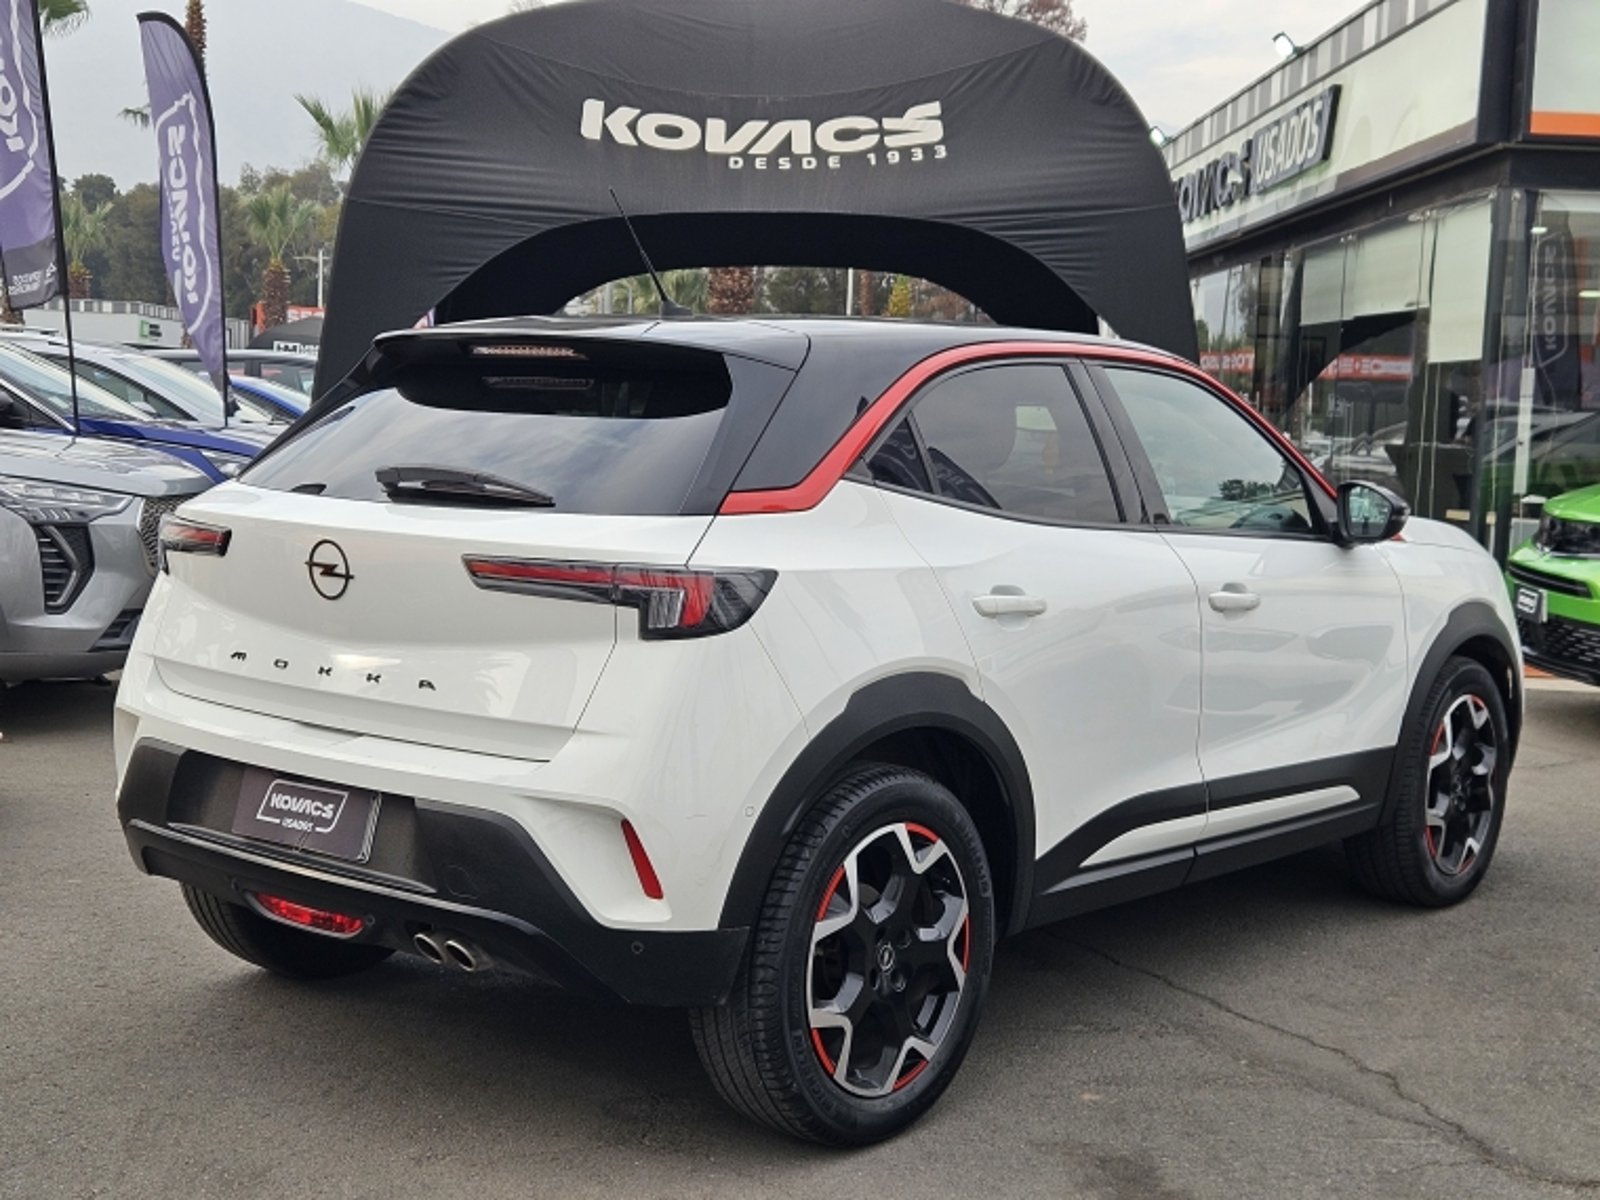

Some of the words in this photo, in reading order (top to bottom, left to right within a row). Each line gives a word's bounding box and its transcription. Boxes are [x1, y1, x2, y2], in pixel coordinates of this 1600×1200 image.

[580, 98, 944, 155] KOVACS
[1256, 101, 1323, 183] USADOS
[728, 155, 841, 170] DESDE
[866, 144, 947, 166] 1933
[230, 651, 436, 690] MOKKA
[270, 793, 335, 819] KOVACS
